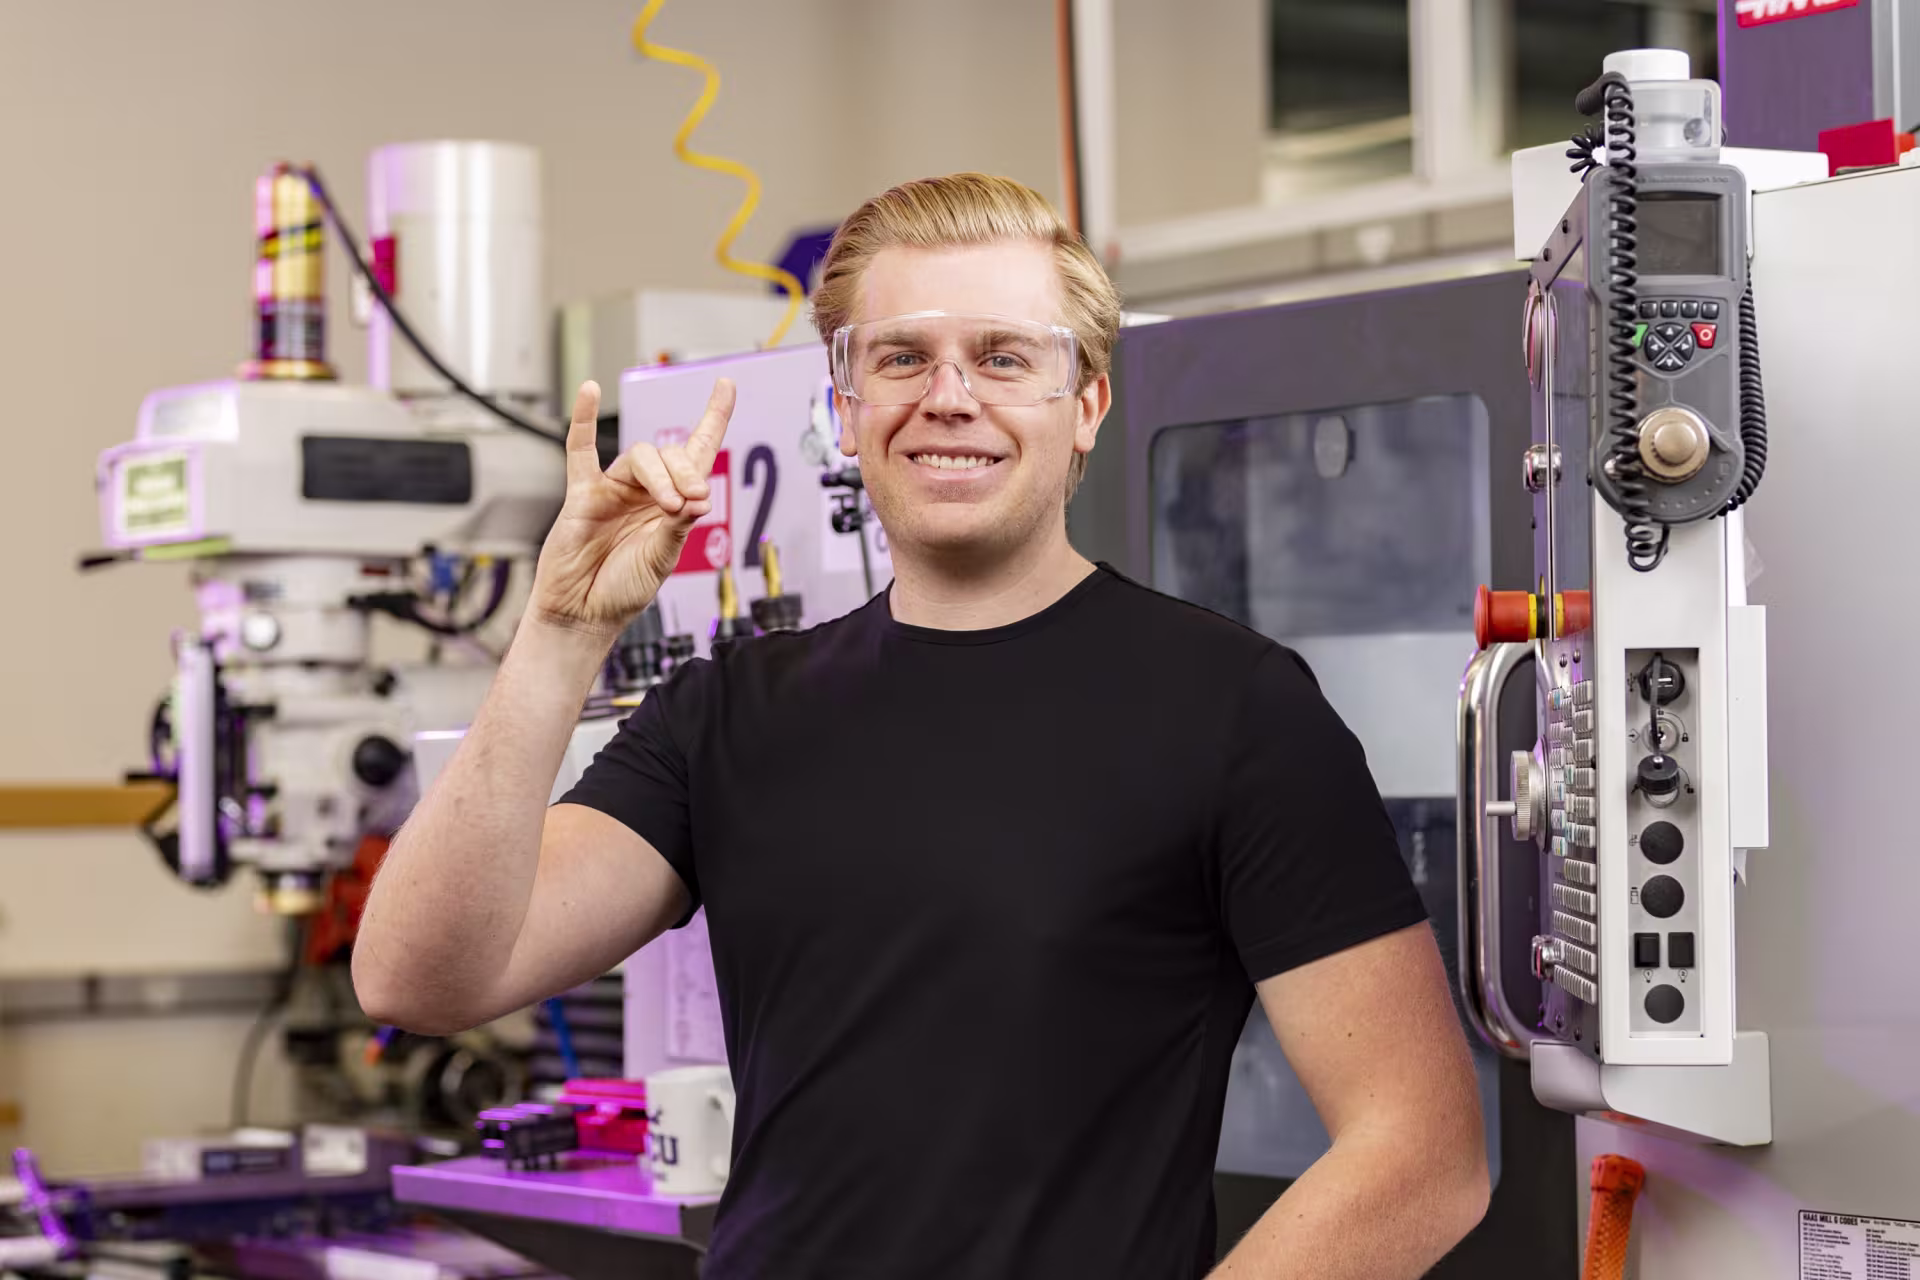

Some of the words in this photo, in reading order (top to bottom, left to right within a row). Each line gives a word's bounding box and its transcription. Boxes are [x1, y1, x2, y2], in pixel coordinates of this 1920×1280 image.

[743, 445, 777, 567] 2
[1803, 1213, 1818, 1222] HAAS
[1819, 1215, 1833, 1223] MILL
[1834, 1216, 1838, 1224] G
[1839, 1216, 1858, 1226] CODES
